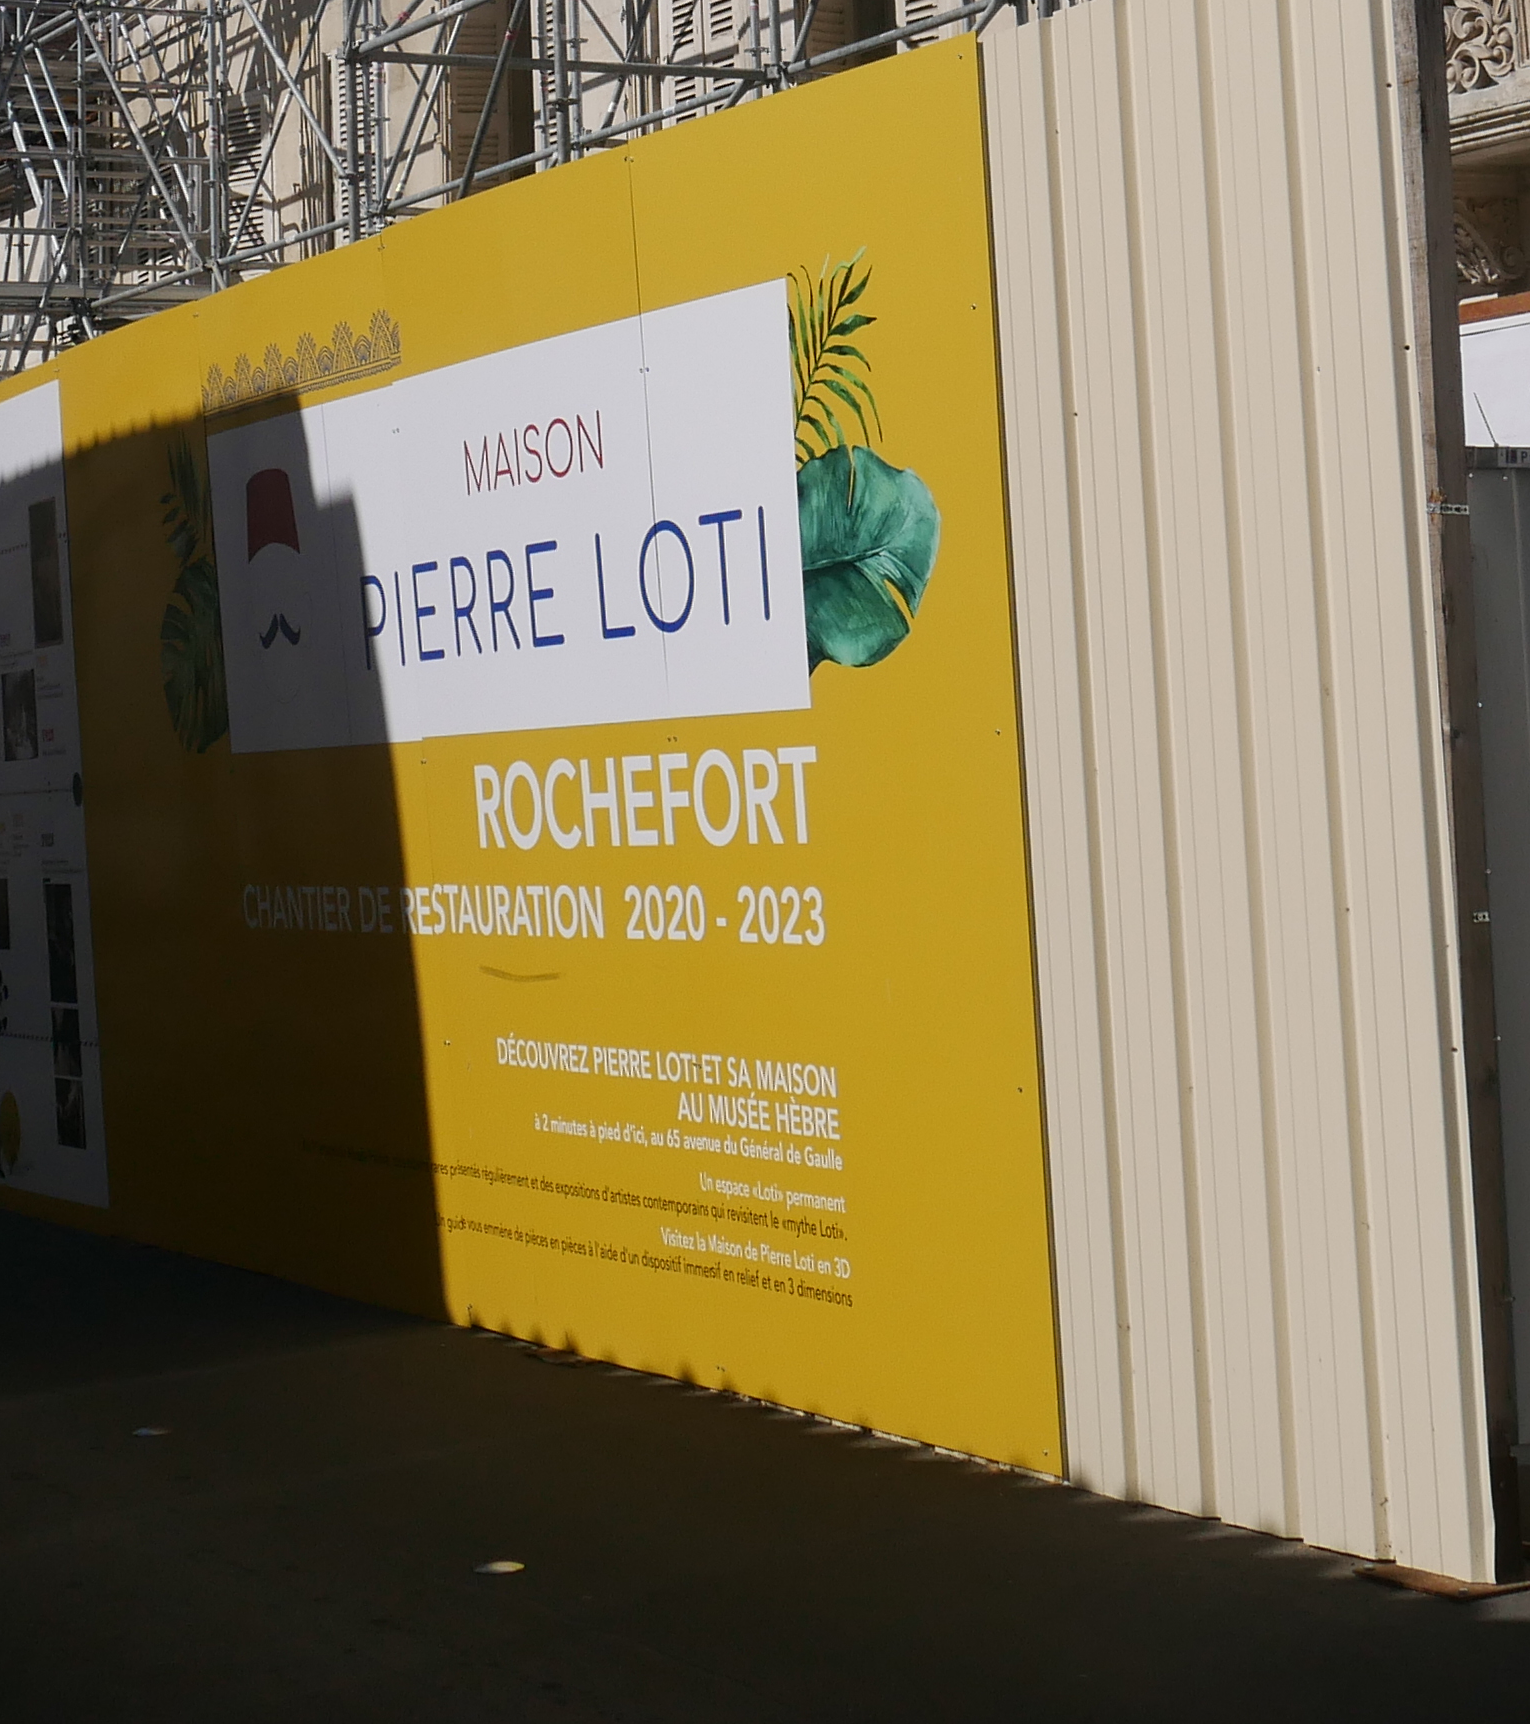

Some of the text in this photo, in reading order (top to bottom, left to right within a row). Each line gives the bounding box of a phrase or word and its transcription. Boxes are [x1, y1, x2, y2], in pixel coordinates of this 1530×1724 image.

[463, 409, 606, 496] MAISON
[360, 505, 772, 670] PIERRE LOTI
[474, 745, 817, 850] ROCHEFORT
[244, 883, 353, 932] CHANTIER
[359, 886, 394, 934] DE
[400, 883, 605, 939] RESTAURATION
[625, 884, 706, 942] 2020
[738, 885, 826, 946] 2023
[497, 1032, 837, 1098] DÉCOUVREZ PIERRE LOTI ET SA MAISON
[534, 1113, 843, 1171] à 2 minutes à pied d'ici, au 65 avenue du Général de Gaulle
[678, 1092, 841, 1140] AU MUSÉE HÈBRE
[531, 1177, 539, 1190] et
[540, 1176, 554, 1192] des
[555, 1182, 600, 1199] expositions
[643, 1196, 709, 1217] contemporains
[711, 1203, 725, 1223] qui
[727, 1206, 768, 1231] revisitent
[770, 1210, 779, 1229] le
[700, 1172, 714, 1191] Un
[715, 1179, 750, 1200] espace
[786, 1191, 846, 1213] permanent
[468, 1220, 482, 1232] vous
[484, 1223, 513, 1240] emmène
[514, 1225, 523, 1242] de
[525, 1229, 549, 1247] pièces
[550, 1238, 560, 1249] en
[561, 1236, 586, 1255] pièces
[588, 1240, 593, 1256] à
[595, 1241, 618, 1262] l'aide
[620, 1246, 639, 1264] d'un
[641, 1253, 681, 1272] dispositif
[683, 1258, 721, 1279] immersif
[723, 1268, 734, 1281] en
[736, 1268, 760, 1287] relief
[761, 1276, 772, 1292] et
[774, 1279, 786, 1292] en
[788, 1277, 795, 1294] 3
[797, 1278, 853, 1307] dimensions
[660, 1226, 851, 1279] Visitez la Maison de Pierre Loti en 3D
